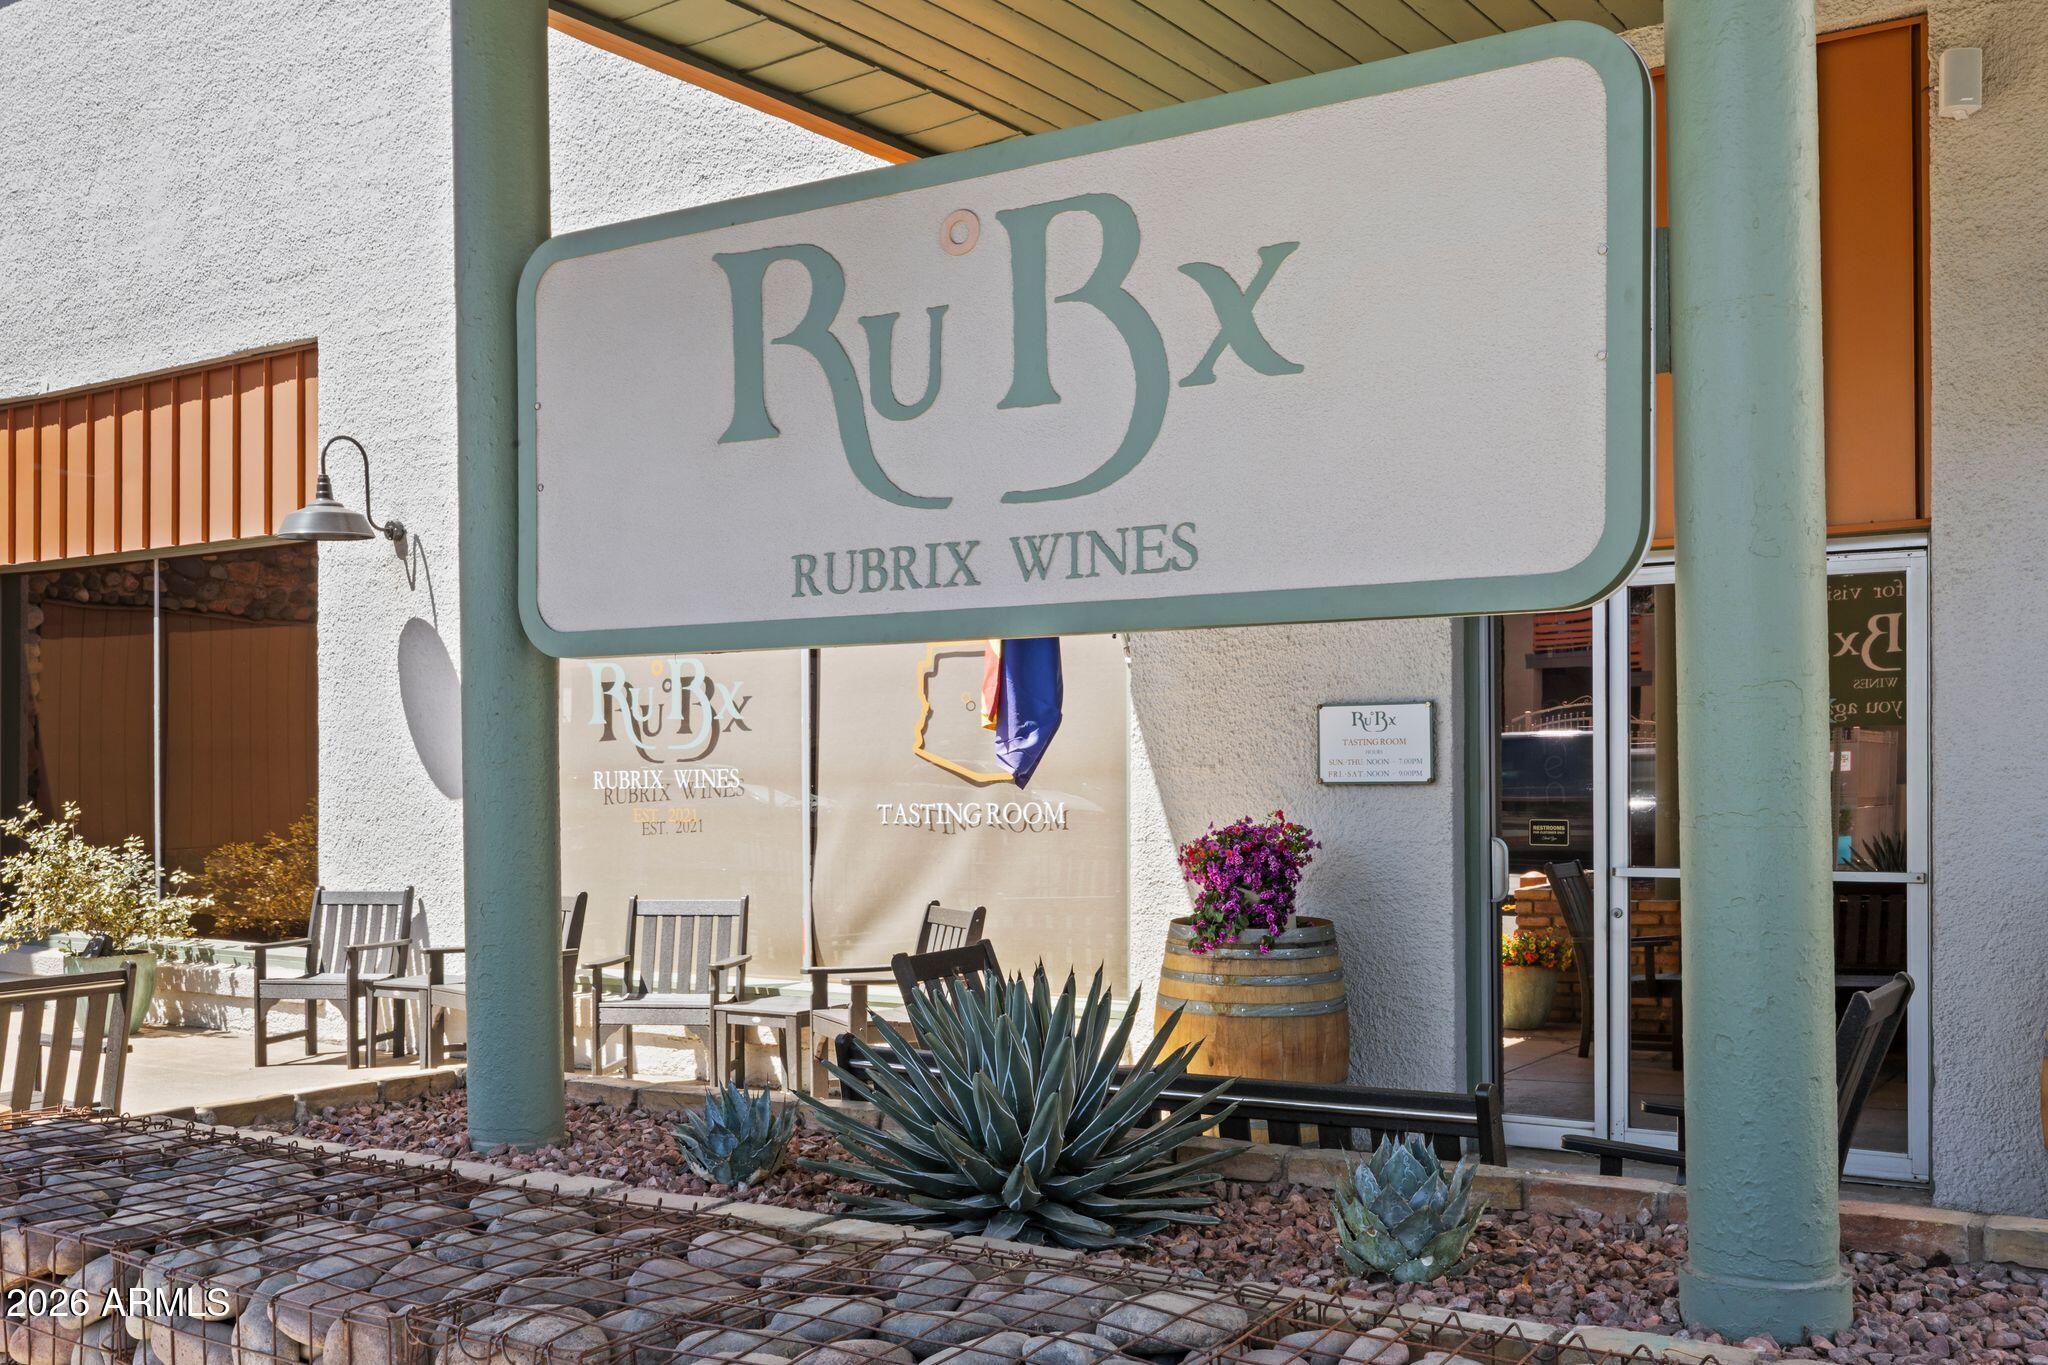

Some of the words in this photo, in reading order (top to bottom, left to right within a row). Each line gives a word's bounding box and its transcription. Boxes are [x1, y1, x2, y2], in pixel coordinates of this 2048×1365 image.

[791, 540, 981, 598] RUBRIX
[1009, 522, 1199, 582] WINES
[1342, 738, 1379, 746] TASTING
[1380, 737, 1407, 745] ROOM
[593, 769, 664, 790] RUBRIX
[674, 768, 740, 789] WINES
[877, 801, 981, 826] TASTING
[986, 801, 1066, 825] ROOM
